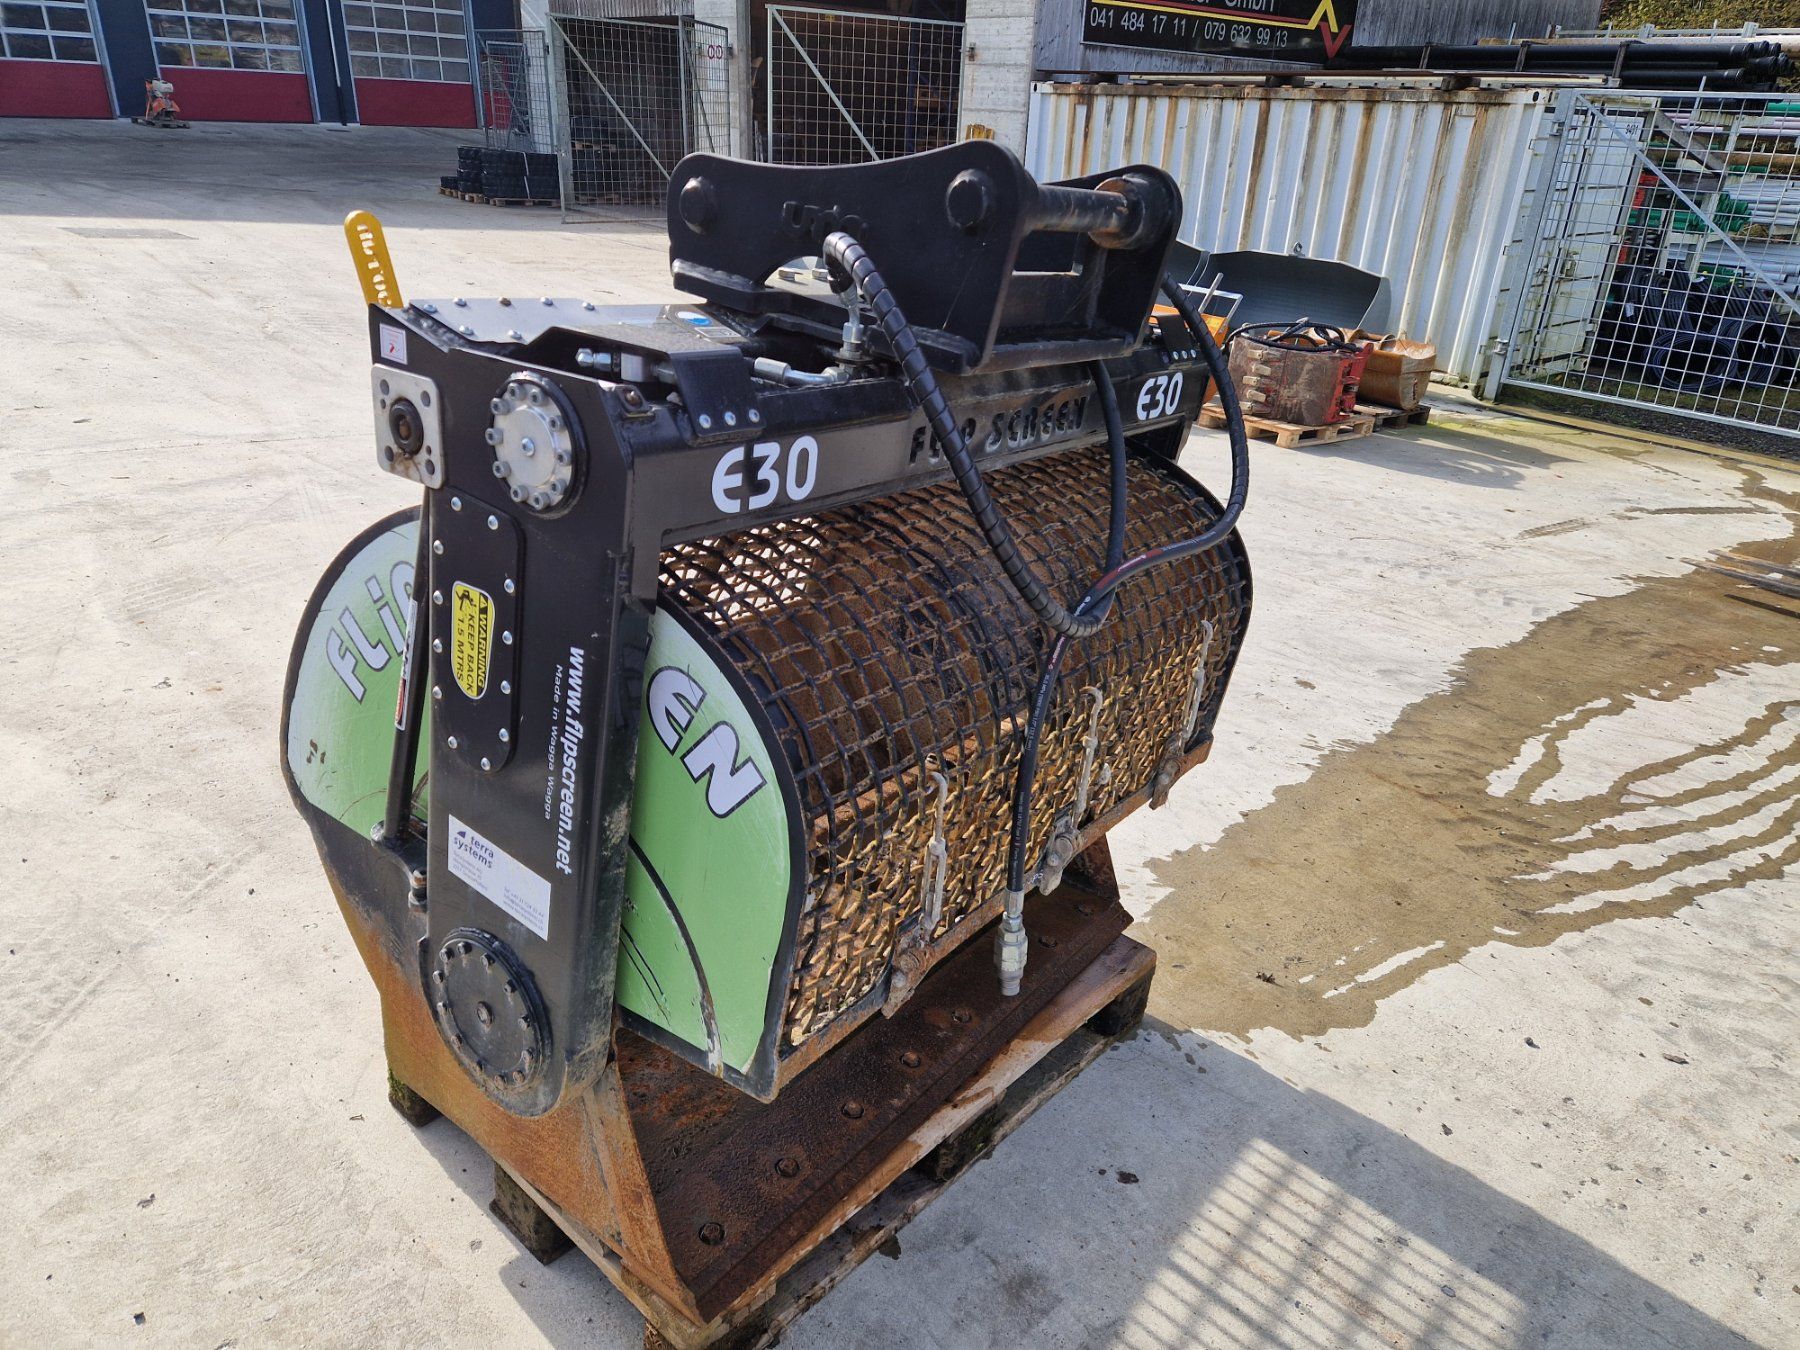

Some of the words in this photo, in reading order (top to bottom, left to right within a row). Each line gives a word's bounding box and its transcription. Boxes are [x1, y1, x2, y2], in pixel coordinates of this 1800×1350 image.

[1090, 7, 1114, 29] 041
[1120, 11, 1145, 32] 484
[1152, 14, 1167, 35] 17
[1173, 18, 1186, 37] 11
[1192, 19, 1200, 38] /
[1204, 21, 1226, 41] 079
[1230, 24, 1251, 44] 632
[1256, 27, 1270, 46] 99
[1276, 29, 1288, 48] 13
[1135, 371, 1184, 421] E30
[909, 417, 977, 464] FLP
[986, 396, 1088, 451] SCREEN
[711, 435, 818, 514] E30
[467, 612, 475, 652] KEEP
[477, 614, 488, 688] WARNING
[456, 638, 464, 682] MTRS
[466, 653, 475, 693] BACK
[553, 664, 563, 703] Made
[552, 707, 559, 721] in
[549, 726, 559, 771] Wagga
[556, 646, 584, 875] www.flipscreen.net
[544, 776, 555, 820] Wagga
[453, 836, 493, 869] systems
[471, 836, 494, 859] terra
